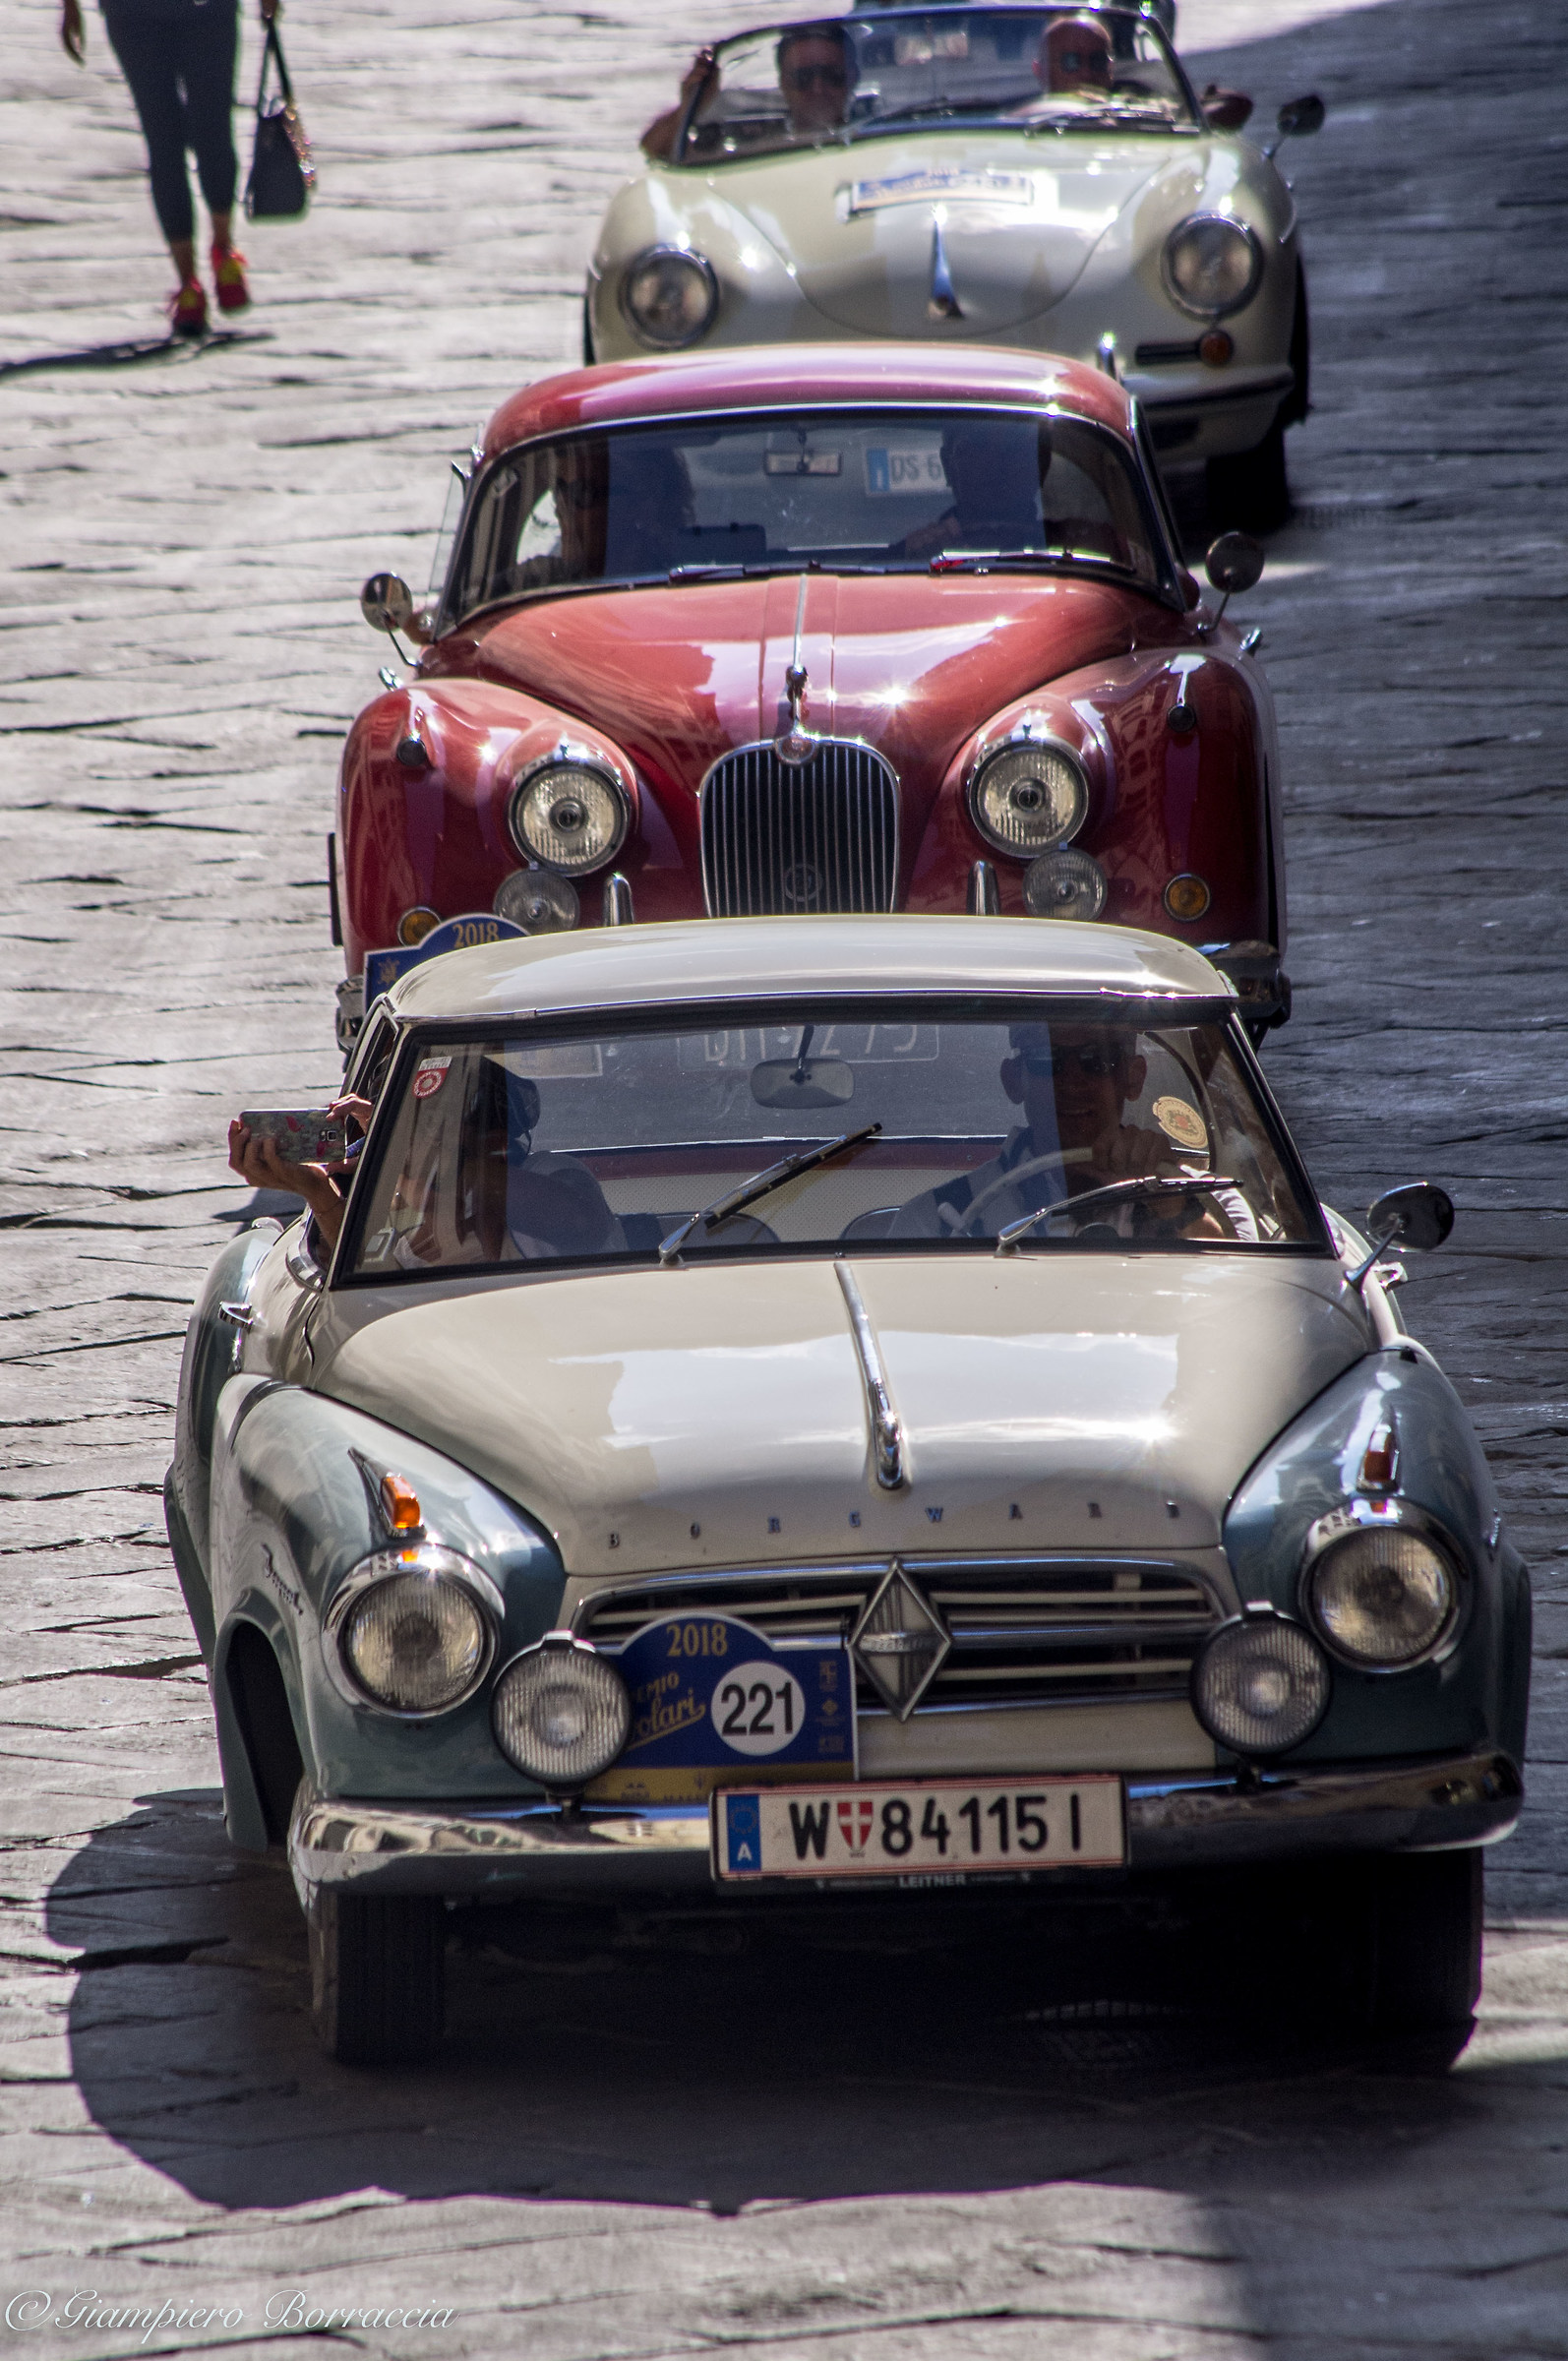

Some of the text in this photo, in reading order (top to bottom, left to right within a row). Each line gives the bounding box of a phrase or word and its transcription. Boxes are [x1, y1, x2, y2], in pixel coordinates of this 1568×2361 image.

[452, 921, 500, 949] 2018
[666, 1621, 728, 1658] 2018
[721, 1681, 793, 1736] 221
[789, 1799, 831, 1861] W
[881, 1795, 1049, 1858] 84115
[737, 1843, 753, 1862] A
[898, 1872, 968, 1890] LEITNER
